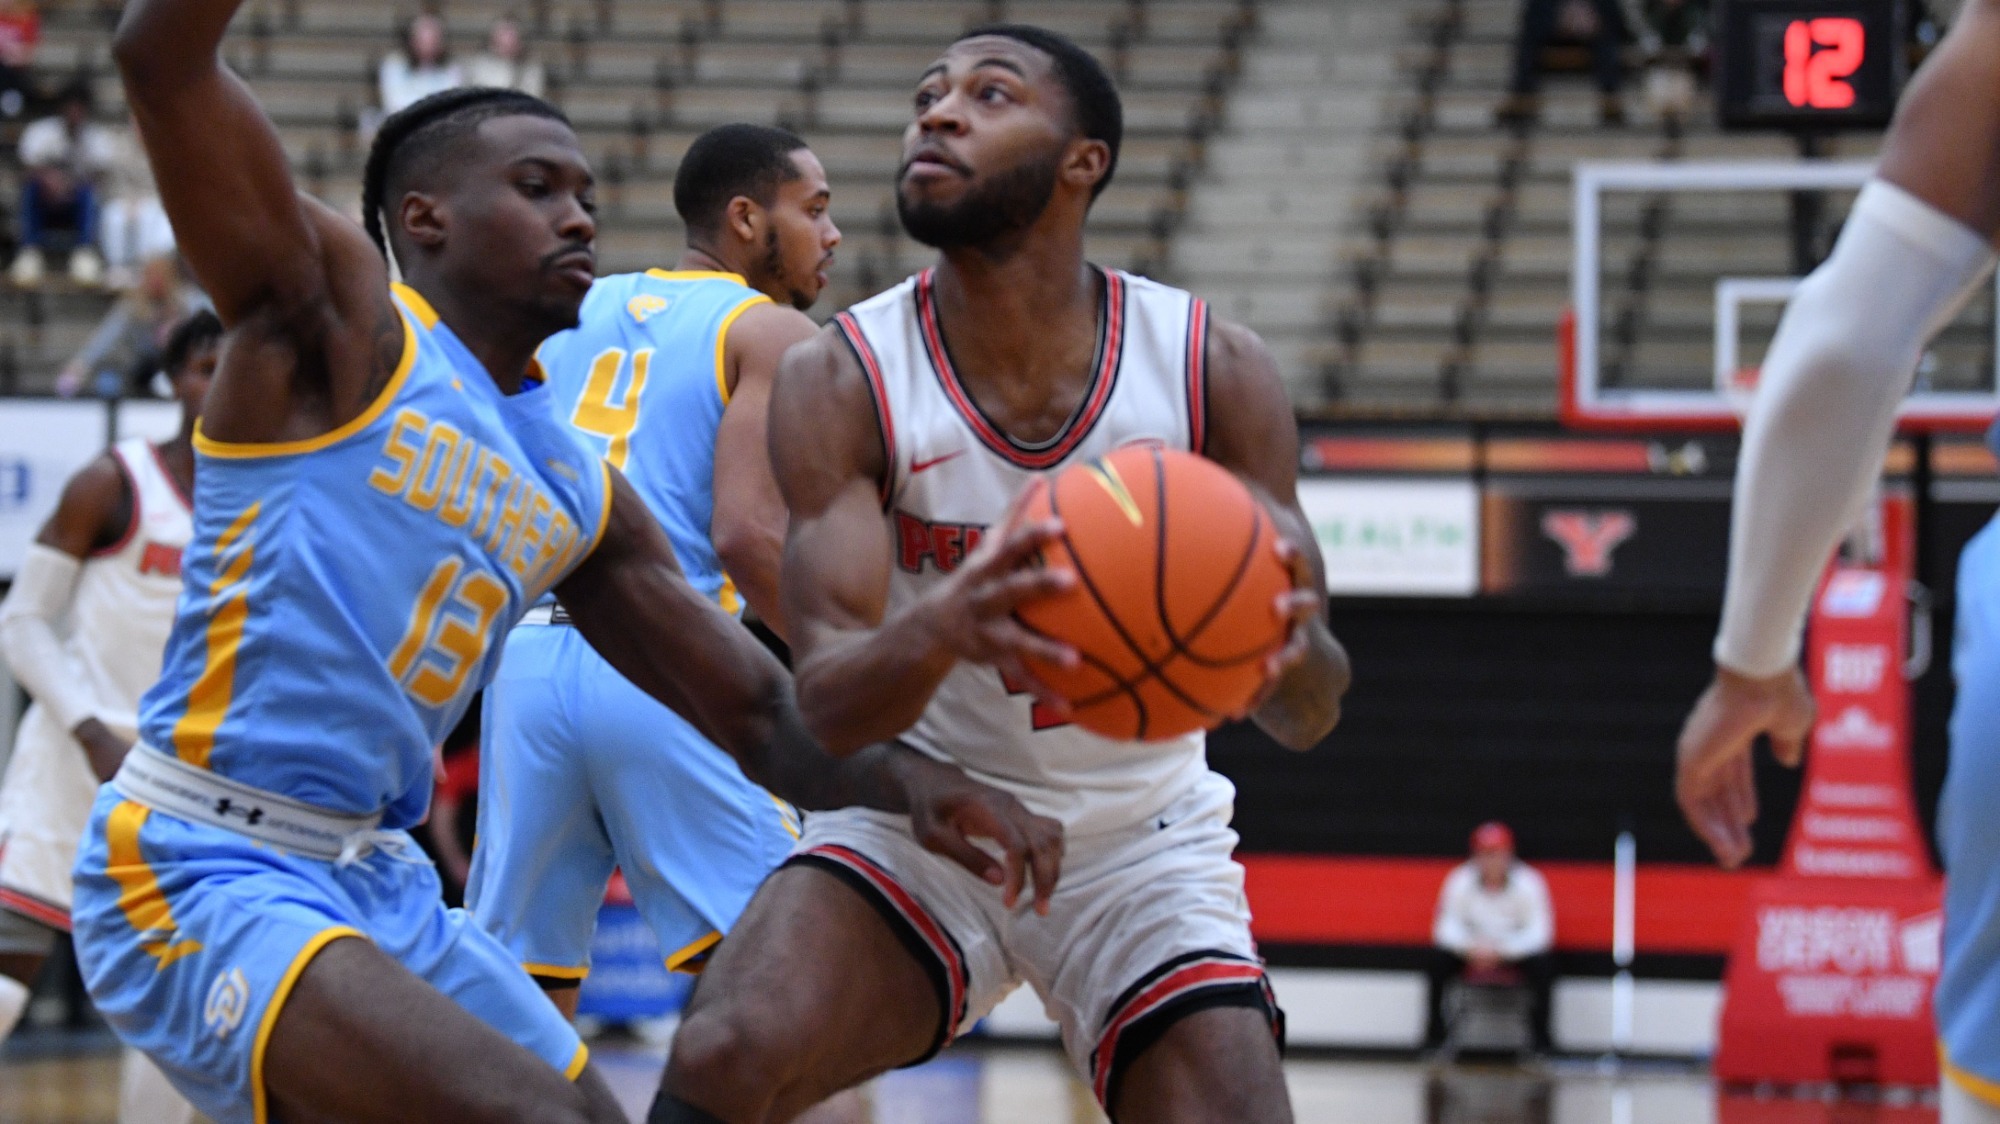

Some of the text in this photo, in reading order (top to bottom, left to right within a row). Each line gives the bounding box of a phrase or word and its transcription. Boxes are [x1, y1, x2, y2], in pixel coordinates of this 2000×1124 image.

[1782, 16, 1866, 109] 12
[568, 346, 657, 474] 4
[1541, 509, 1638, 578] Y
[388, 555, 512, 708] 13
